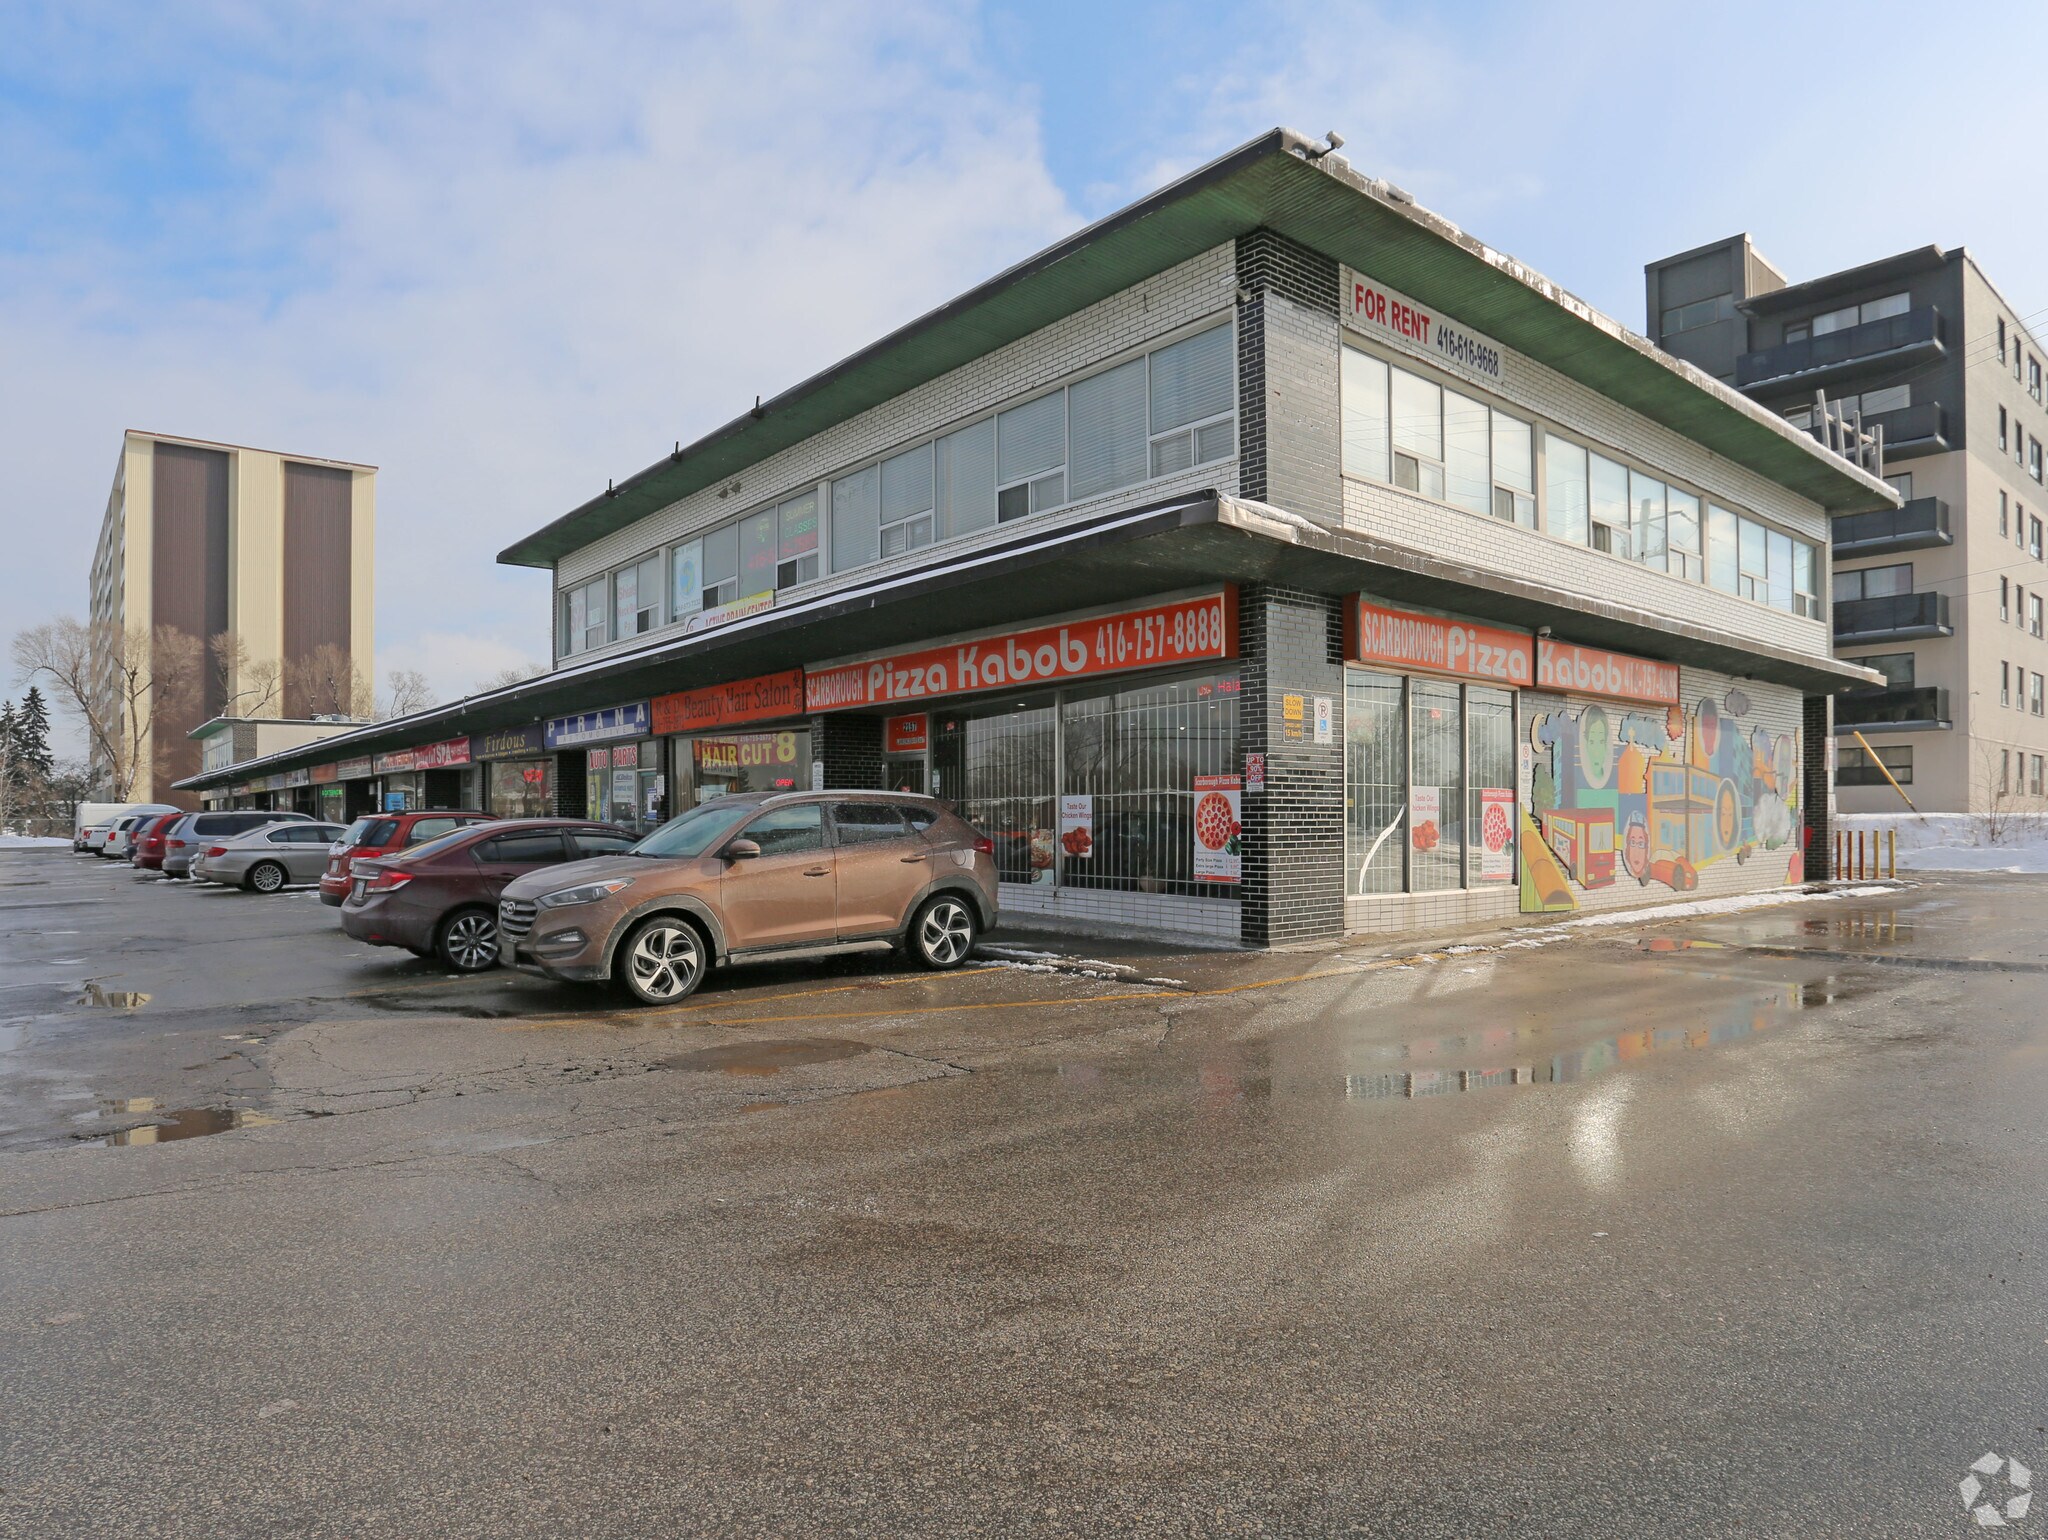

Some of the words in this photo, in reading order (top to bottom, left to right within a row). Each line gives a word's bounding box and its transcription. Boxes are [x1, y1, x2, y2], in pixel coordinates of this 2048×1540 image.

[1355, 283, 1386, 326] FOR
[1391, 300, 1430, 345] RENT
[1437, 324, 1499, 377] 416-616-9668
[1364, 611, 1444, 665] SCARBOROUGH
[1447, 626, 1527, 680] Pizza
[806, 669, 863, 708] SCARBOROUGH
[868, 661, 948, 702] Pizza
[957, 628, 1088, 689] Kabob
[1096, 605, 1221, 665] 416-757-8888
[1537, 642, 1622, 694] Kabob
[684, 695, 725, 722] Beauty
[725, 686, 750, 713] Hair
[754, 679, 791, 709] Salon
[1285, 699, 1301, 707] SLOW
[1285, 707, 1302, 716] DOWN
[547, 703, 645, 738] PIRANA
[485, 730, 526, 753] Firdous
[562, 725, 629, 742] AUTOMOTIVE
[1285, 729, 1291, 737] 15
[437, 743, 452, 764] SPA
[589, 749, 608, 771] AUTO
[612, 745, 637, 769] PARTS
[702, 745, 738, 766] HAIR
[741, 742, 772, 766] CUT
[1246, 756, 1255, 765] UP
[1255, 756, 1264, 765] TO
[775, 778, 793, 787] OPEN
[1195, 777, 1218, 786] Scarborough
[1219, 776, 1230, 785] Pizza
[1250, 774, 1262, 783] OFF
[1066, 802, 1078, 810] Taste
[1078, 802, 1087, 810] Our
[1411, 804, 1426, 812] hicken
[1427, 804, 1440, 814] Wings
[1062, 811, 1078, 820] Chicken
[1079, 811, 1092, 821] Wings
